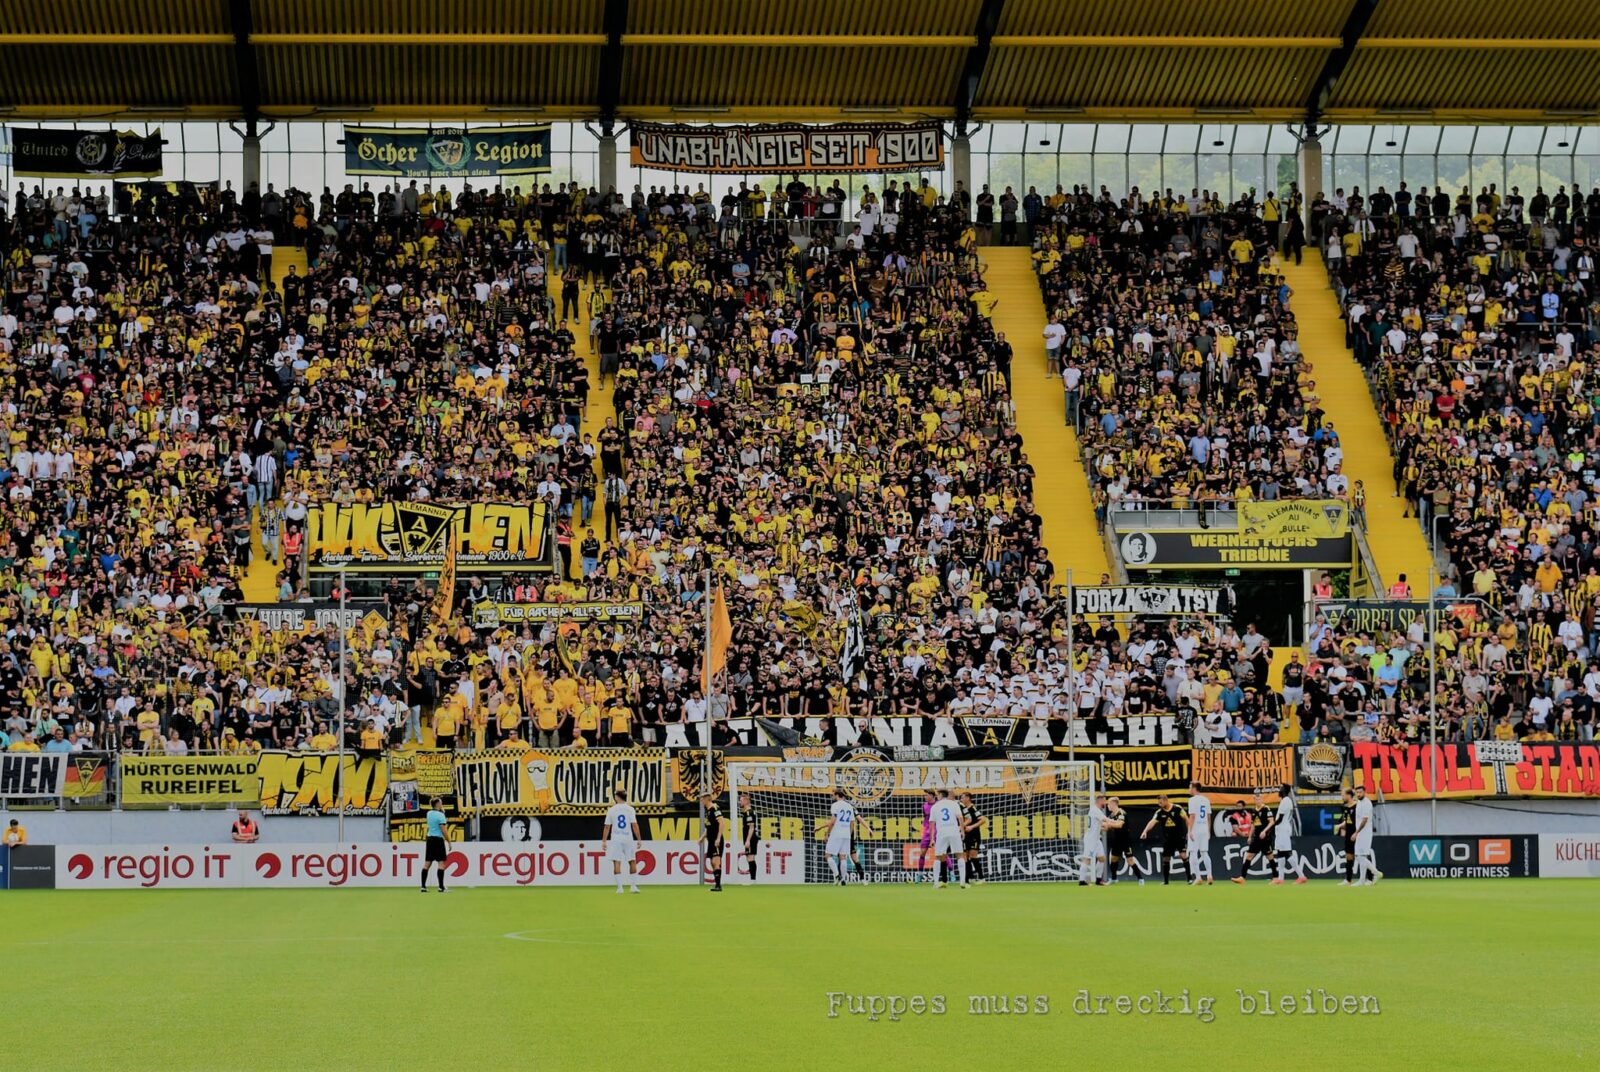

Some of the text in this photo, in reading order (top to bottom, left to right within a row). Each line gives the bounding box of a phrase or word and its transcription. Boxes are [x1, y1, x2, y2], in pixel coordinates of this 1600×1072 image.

[358, 138, 543, 166] Öcher Legion
[640, 129, 939, 167] UNABHÄNGIG SEIT 1900
[1190, 534, 1318, 547] WERNER FUCHS
[1218, 548, 1290, 562] TRIBÜNE
[1075, 587, 1138, 614] FORZA
[967, 718, 1013, 726] ALEMANNIA
[124, 761, 257, 776] HÜRTGENWALD
[1197, 748, 1288, 769] FREUNDSCHAFT
[1352, 741, 1485, 794] TIVOLI
[1125, 760, 1191, 781] WACHT
[1196, 766, 1289, 787] ZUSAMMENHALT
[141, 780, 243, 795] RUREIFEL
[457, 760, 519, 807] YELLOW
[554, 760, 662, 804] CONNECTION
[617, 814, 626, 829] 8
[839, 809, 850, 822] 22
[941, 807, 950, 821] 3
[1200, 805, 1206, 819] 5
[815, 816, 924, 840] FCHS
[104, 846, 194, 887] regio
[292, 845, 382, 885] regio
[479, 844, 570, 884] regio
[1410, 867, 1509, 877] WORLD OF FITNESS
[874, 872, 888, 882] OF
